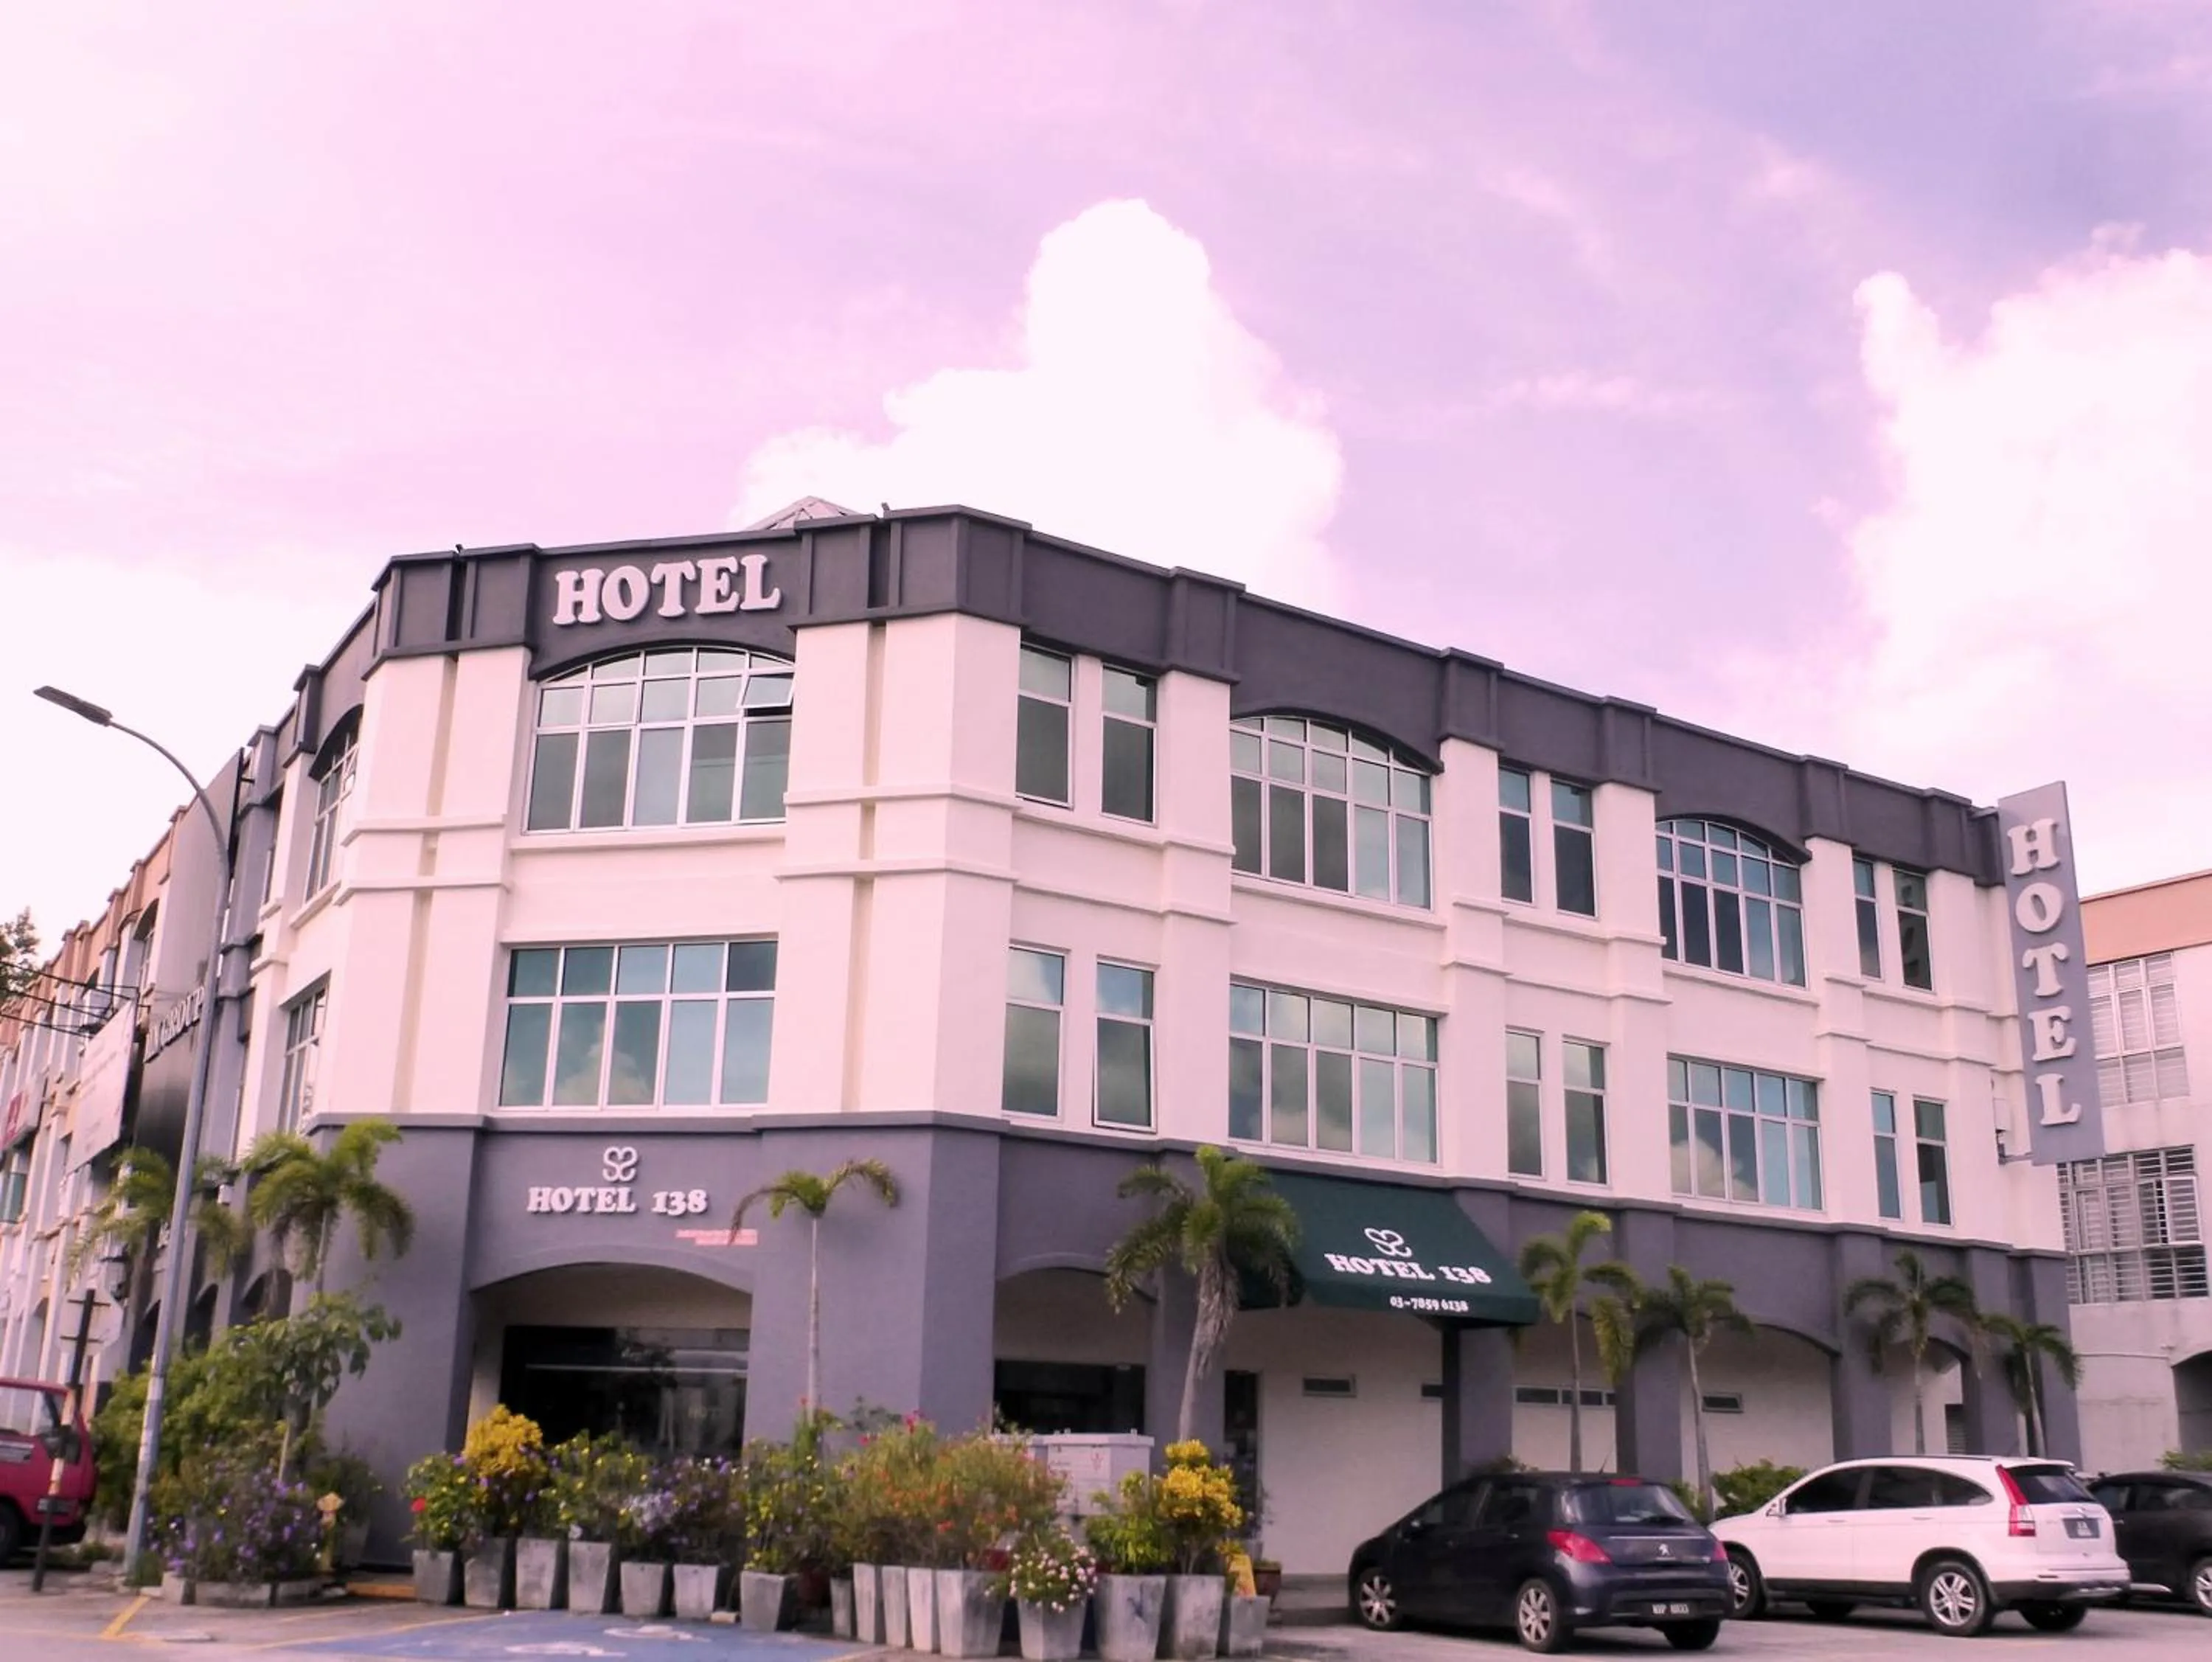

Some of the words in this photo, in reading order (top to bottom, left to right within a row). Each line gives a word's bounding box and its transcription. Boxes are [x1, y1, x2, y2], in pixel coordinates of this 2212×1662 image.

[552, 554, 782, 625] HOTEL
[2006, 818, 2081, 1126] HOTEL
[526, 1186, 636, 1213] HOTEL
[651, 1189, 709, 1216] 138
[1324, 1253, 1436, 1281] HOTEL
[1439, 1266, 1492, 1284] 138
[1441, 1298, 1469, 1312] 6138
